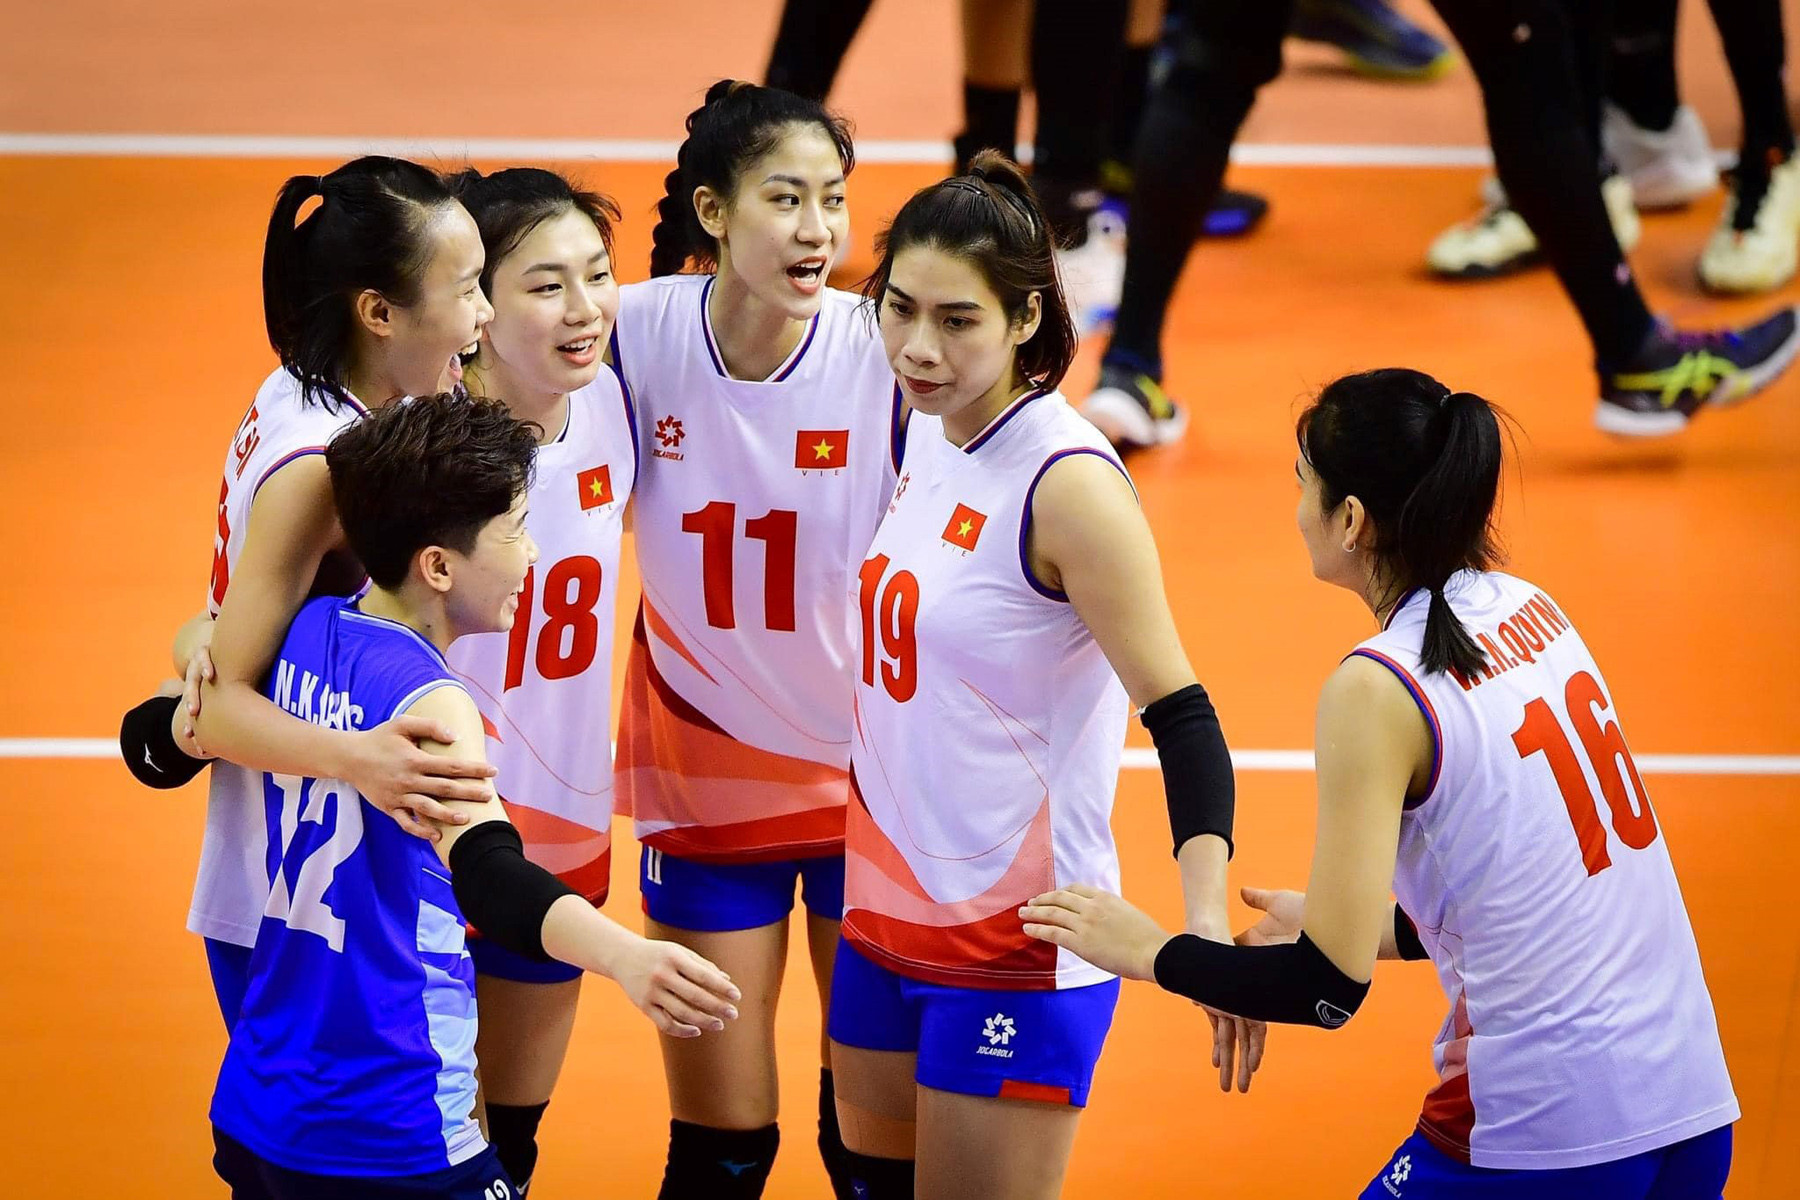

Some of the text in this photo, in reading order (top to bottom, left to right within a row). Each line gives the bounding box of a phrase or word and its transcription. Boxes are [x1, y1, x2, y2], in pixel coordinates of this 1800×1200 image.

[802, 470, 839, 478] VIE
[682, 501, 798, 632] 11
[941, 541, 967, 557] VIE
[503, 554, 602, 693] 18
[858, 552, 920, 703] 19
[1511, 670, 1659, 877] 16
[264, 771, 365, 954] 12
